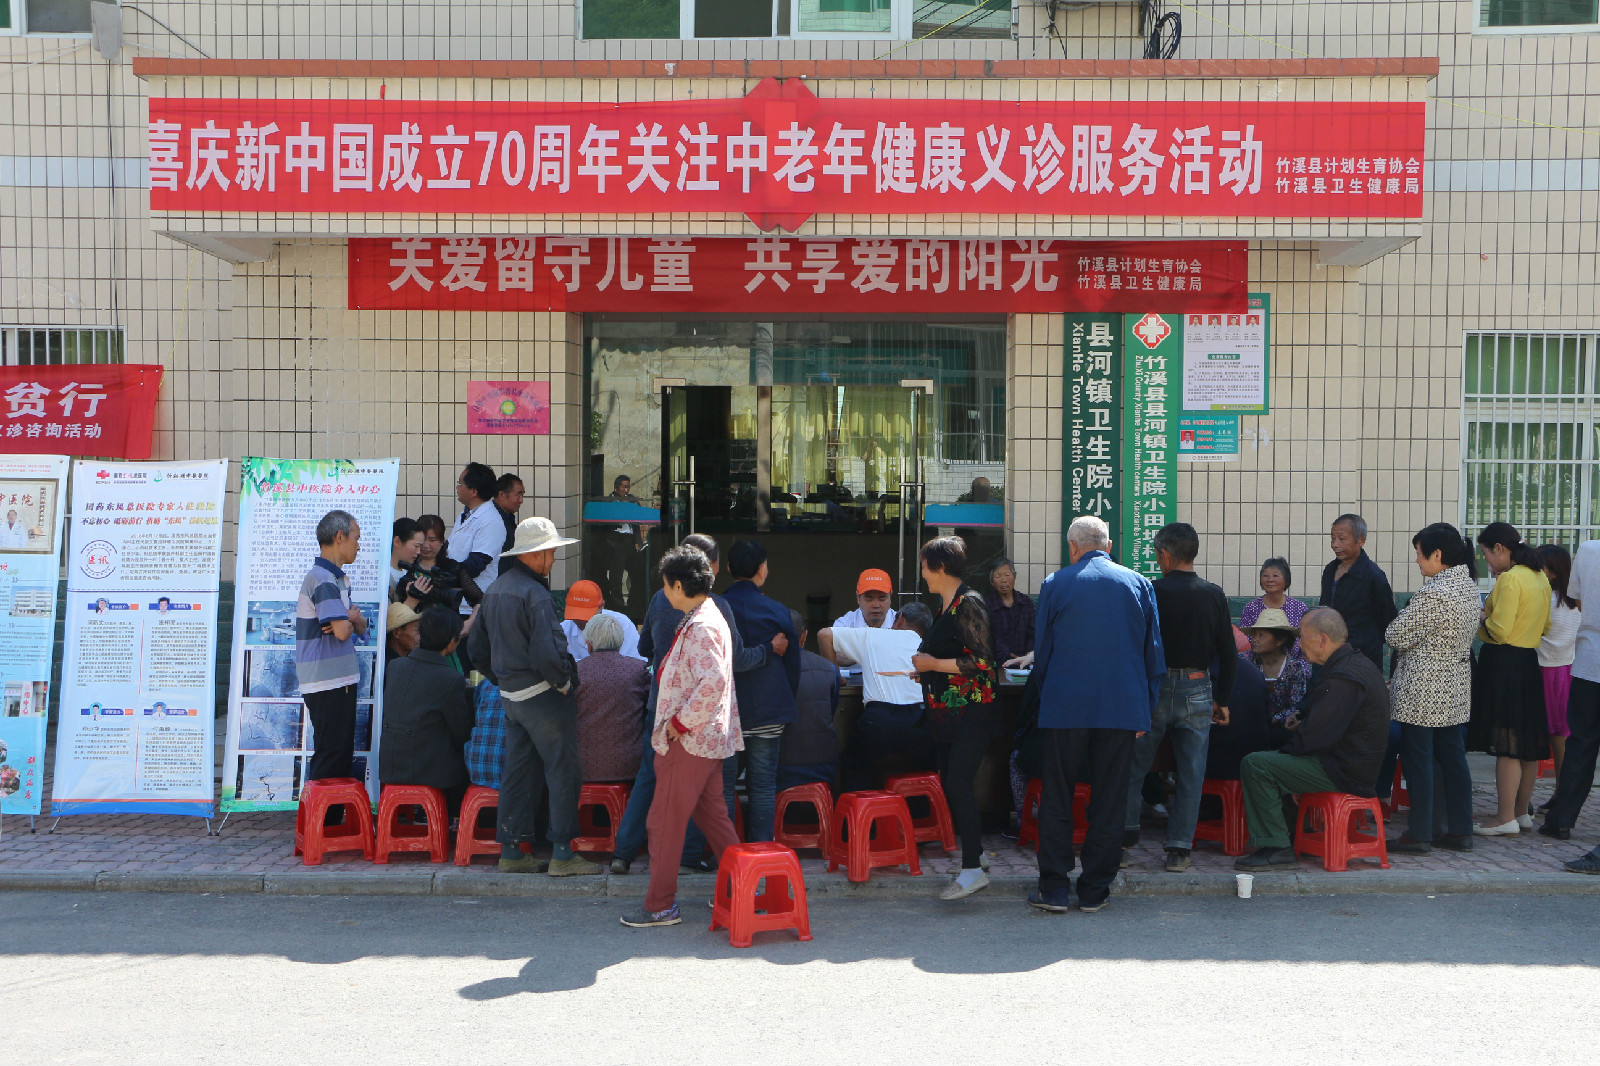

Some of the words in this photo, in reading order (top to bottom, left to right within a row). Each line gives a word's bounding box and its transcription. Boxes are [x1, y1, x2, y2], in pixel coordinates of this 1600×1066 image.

[149, 119, 1263, 196] 喜庆新中国成立70周年关注中老年健康义诊服务活动
[1276, 157, 1420, 174] 竹溪县计划生育协会
[1275, 177, 1420, 194] 竹溪县卫生健康局
[388, 237, 696, 292] 关爱留守儿童
[744, 238, 1059, 293] 共享爱的阳光
[1078, 257, 1202, 274] 竹溪县计划生育协会
[1077, 275, 1202, 291] 竹溪县卫生健康局
[1072, 322, 1084, 372] XianHe
[4, 381, 107, 418] 贫行
[1072, 376, 1084, 414] Town
[1133, 377, 1143, 401] County
[1134, 402, 1142, 426] Xianhe
[0, 423, 102, 438] 诊咨询活动
[1072, 420, 1083, 462] Health
[1086, 322, 1113, 540] 县河镇卫生院小
[1134, 428, 1142, 446] Town
[1134, 448, 1142, 471] Health
[1142, 355, 1168, 581] 竹溪县县河镇卫生院小田坝村卫
[260, 482, 380, 494] 竹溪县中医院介入中心
[1072, 467, 1084, 512] Center
[1134, 472, 1142, 496] centers
[1132, 538, 1141, 560] Village
